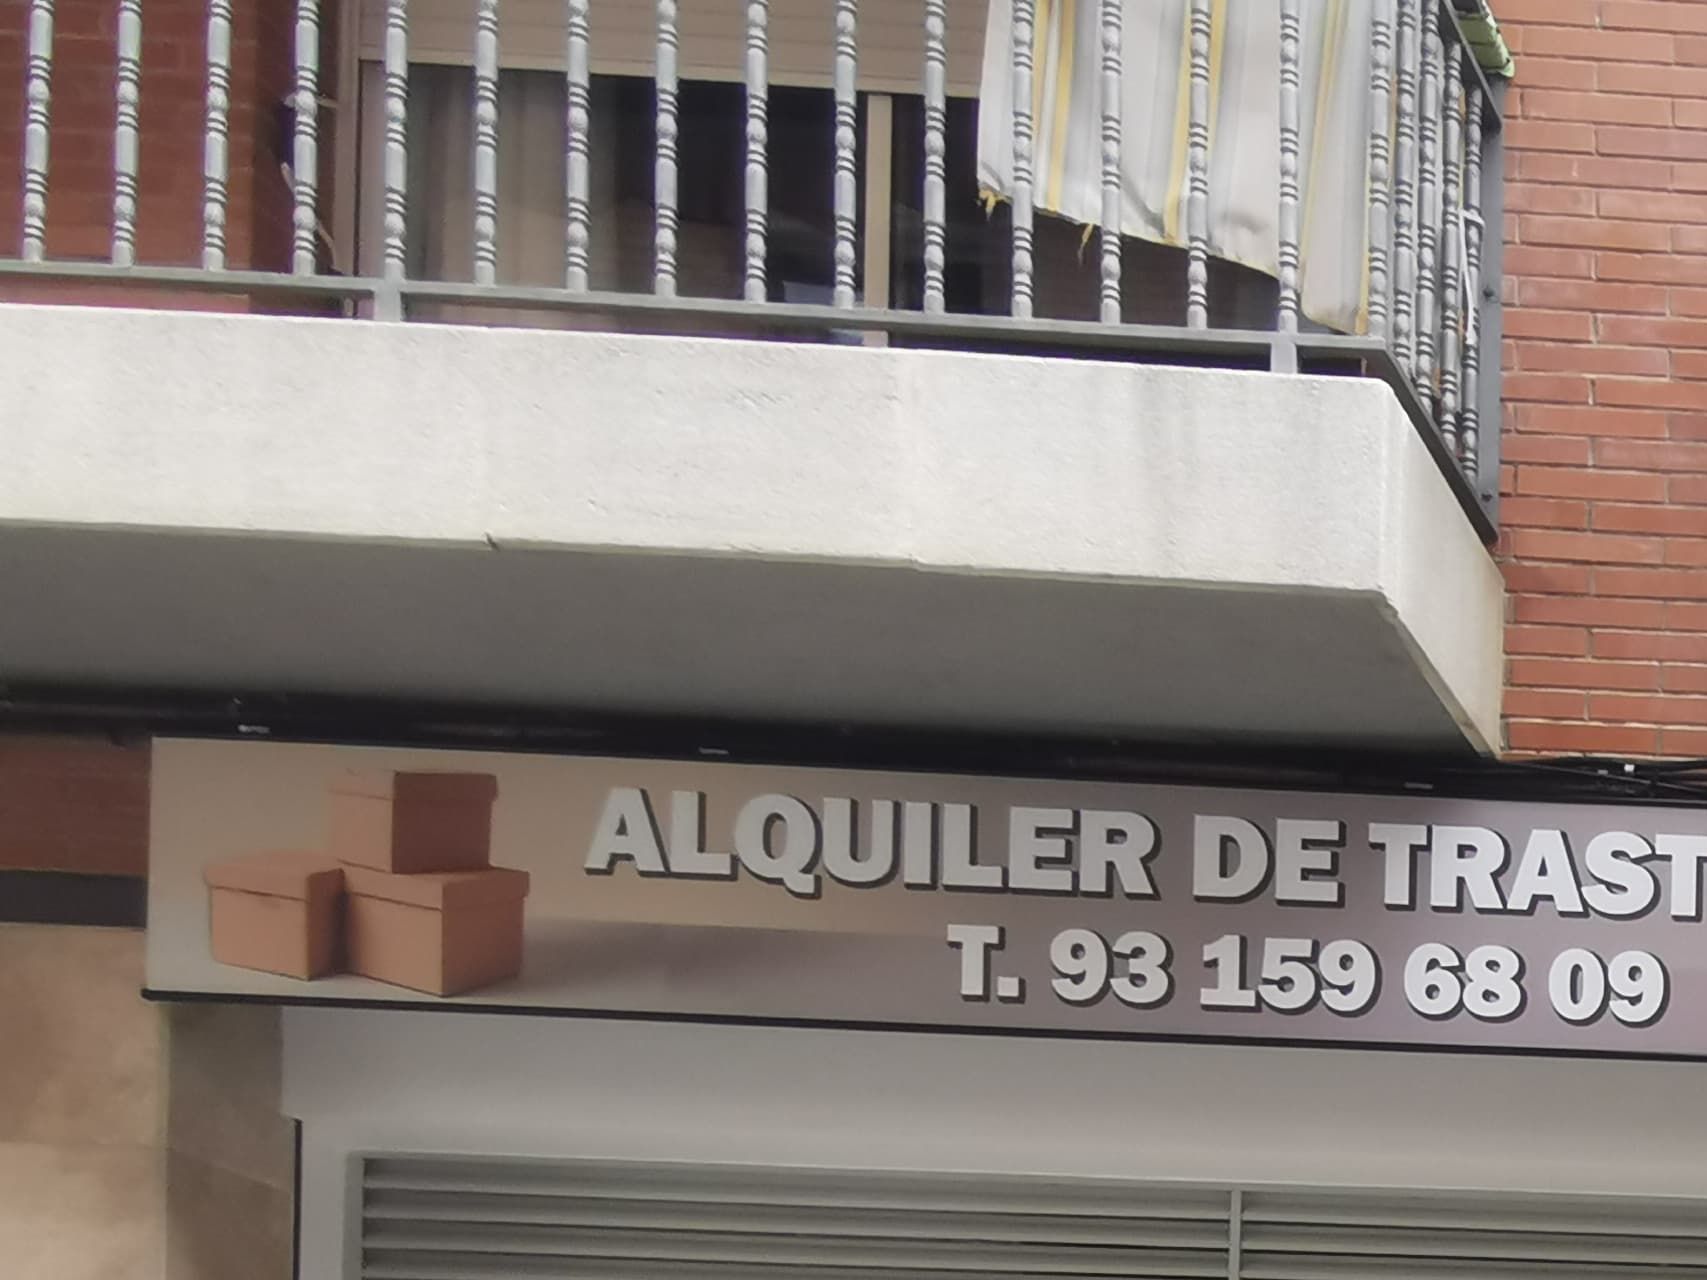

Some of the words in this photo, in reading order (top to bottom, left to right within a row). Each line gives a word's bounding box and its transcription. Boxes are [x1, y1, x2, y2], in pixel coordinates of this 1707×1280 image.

[584, 787, 1157, 899] ALQUILER
[1192, 814, 1345, 906] DE
[946, 924, 1025, 1001] T.
[1050, 928, 1173, 1009] 93
[1200, 934, 1381, 1017] 159
[1404, 942, 1527, 1023] 68
[1549, 947, 1670, 1028] 09
